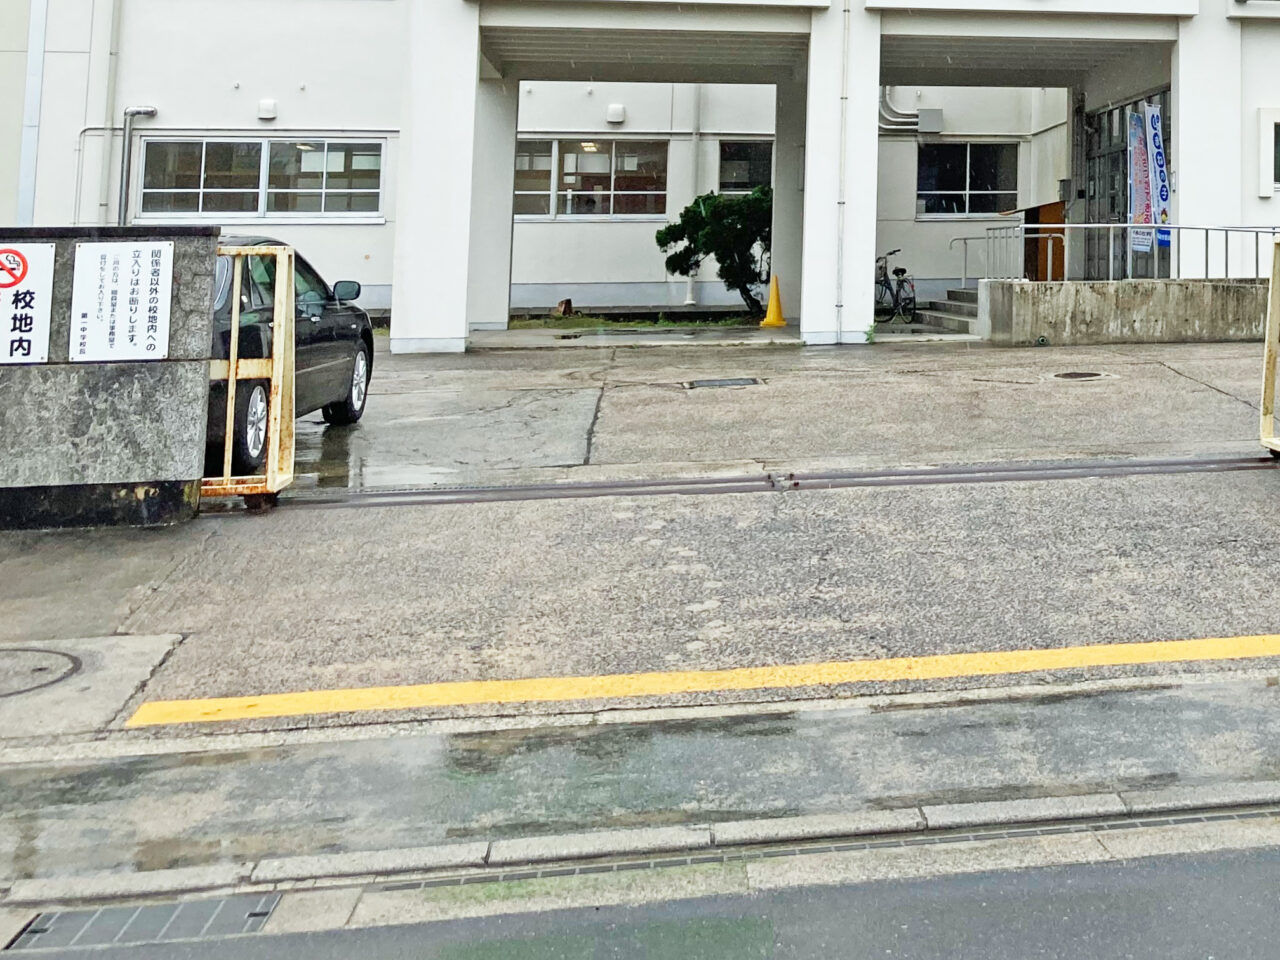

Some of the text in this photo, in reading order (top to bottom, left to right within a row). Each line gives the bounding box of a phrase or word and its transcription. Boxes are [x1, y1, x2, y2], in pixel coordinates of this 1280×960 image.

[9, 289, 35, 357] 校地内
[128, 249, 142, 347] 立入りはお断りします。
[145, 249, 162, 352] 関係者以外の校地内への
